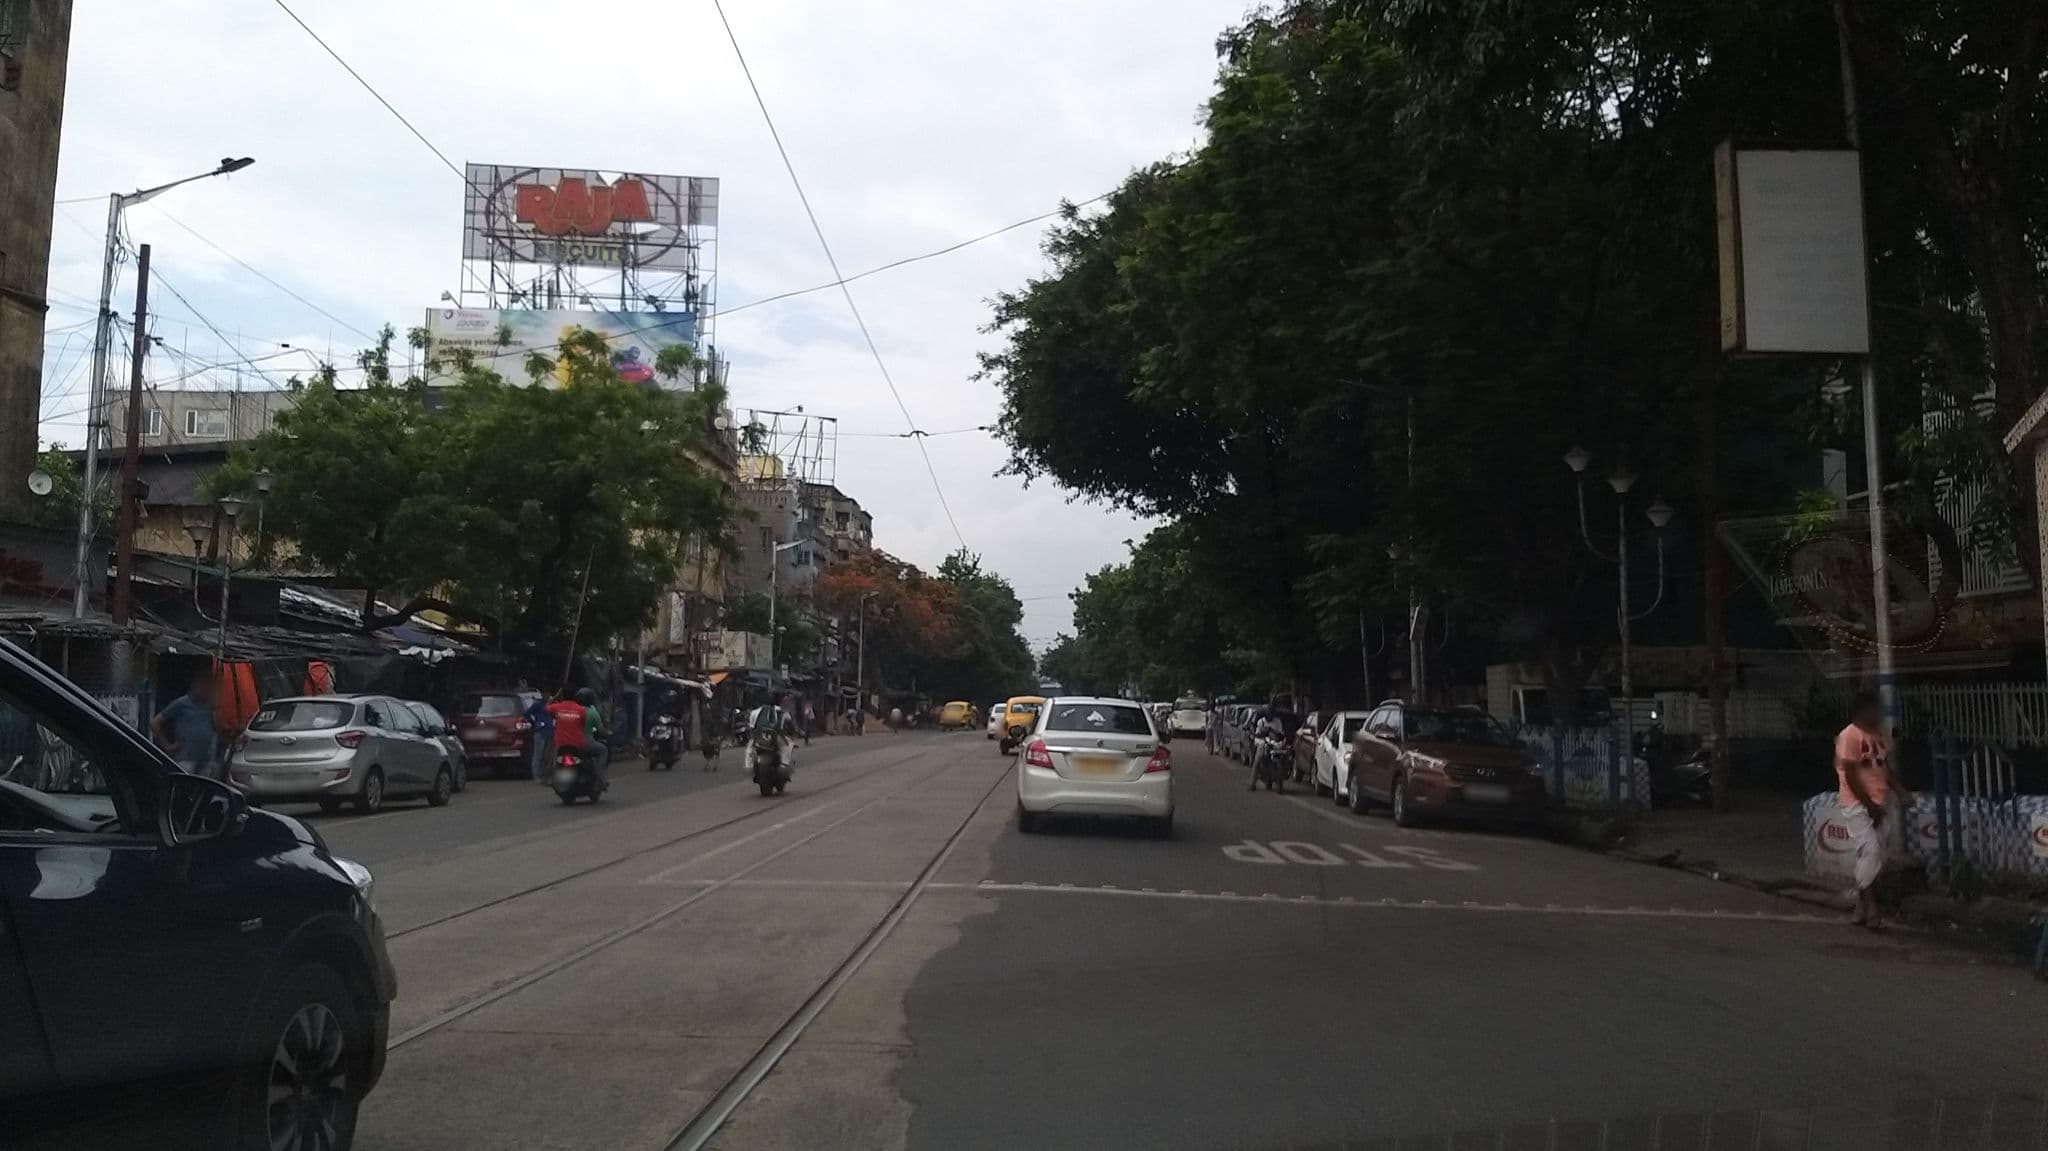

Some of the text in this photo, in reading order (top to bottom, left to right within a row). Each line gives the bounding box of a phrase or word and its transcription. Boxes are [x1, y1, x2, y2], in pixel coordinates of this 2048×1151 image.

[515, 177, 653, 236] RAJA
[535, 241, 628, 262] BISCUITS
[1222, 840, 1480, 870] STOP
